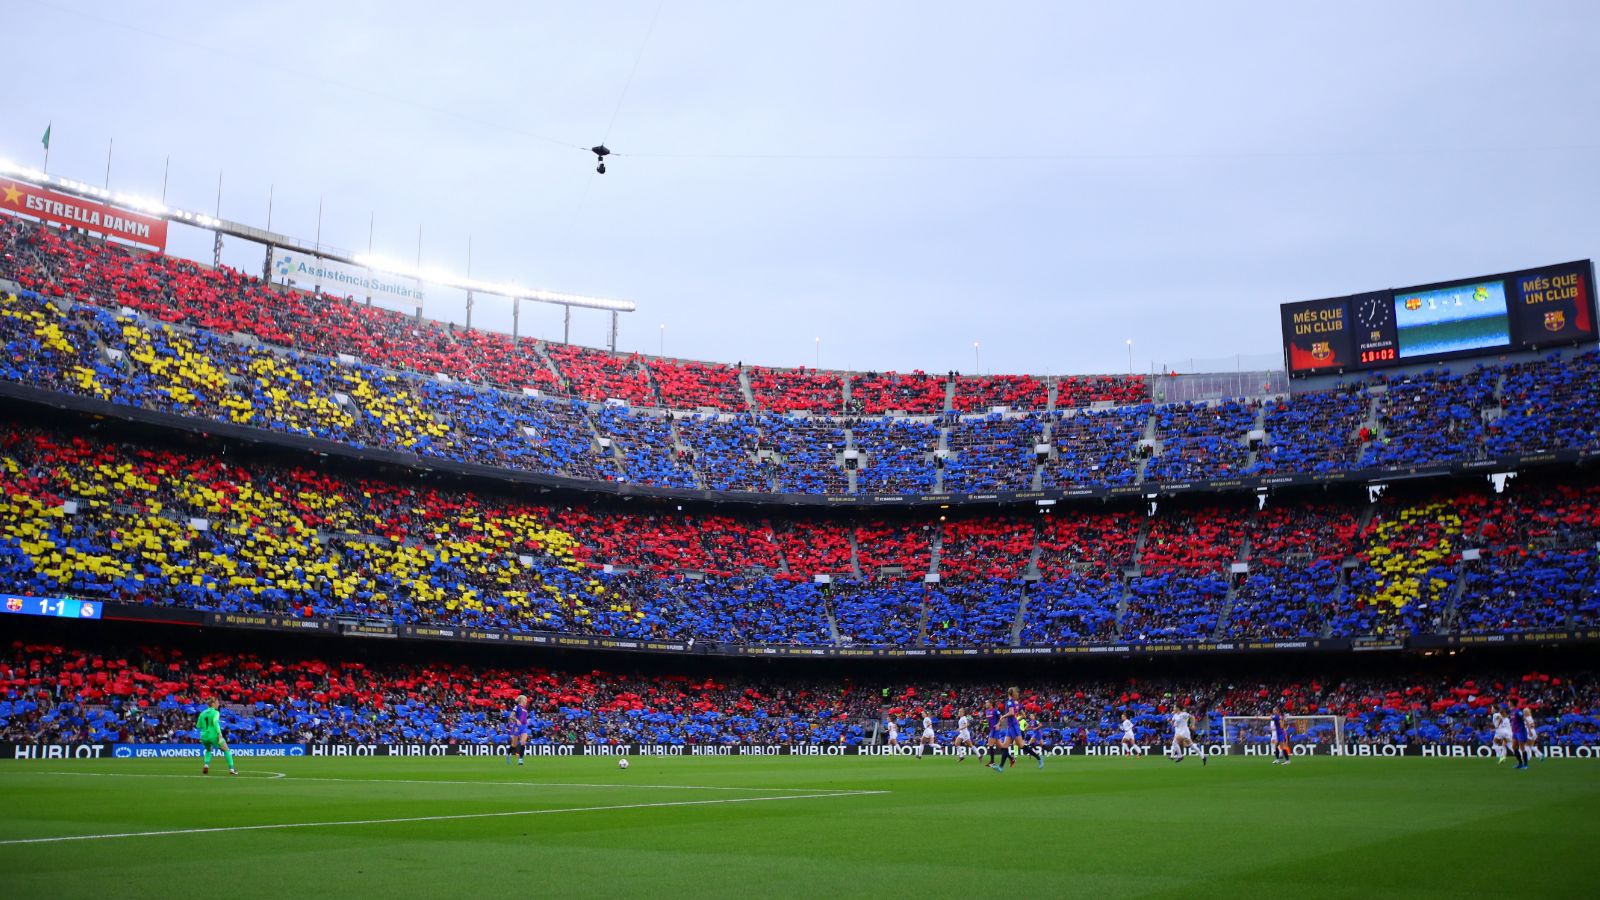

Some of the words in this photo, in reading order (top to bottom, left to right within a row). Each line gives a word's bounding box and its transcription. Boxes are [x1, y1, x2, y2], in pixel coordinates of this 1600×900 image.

[25, 194, 100, 226] ESTRELLA
[103, 214, 150, 238] DAMM
[1522, 278, 1548, 292] MÉS
[1551, 273, 1578, 288] QUE
[1427, 298, 1436, 309] 1
[1455, 294, 1463, 305] 1
[1525, 292, 1543, 304] UN
[1546, 287, 1579, 301] CLUB
[1293, 310, 1318, 323] MÉS
[1320, 308, 1343, 321] QUE
[1295, 323, 1312, 335] UN
[1314, 320, 1343, 332] CLUB
[39, 599, 65, 615] 1-1
[204, 716, 210, 727] 1
[15, 744, 104, 759] HUBLOT
[136, 748, 158, 757] UEFA
[159, 748, 201, 757] WOMEN'S
[203, 748, 255, 757] CHAPIONS
[256, 748, 286, 756] LEAGUE
[312, 744, 377, 756] HUBLOT
[388, 744, 449, 756] HUBLOT
[523, 745, 575, 756] HUBLOT
[583, 745, 631, 756] HUBLOT
[639, 745, 685, 756] HUBLOT
[691, 745, 732, 756] HUBLOT
[739, 745, 781, 756] HUBLOT
[790, 745, 847, 756] HUBLOT
[858, 745, 920, 756] HUBLOT
[933, 745, 997, 756] HUBLO
[1008, 745, 1074, 756] HBOT
[1244, 744, 1316, 756] HUOT
[1330, 744, 1408, 757] HUBLOT
